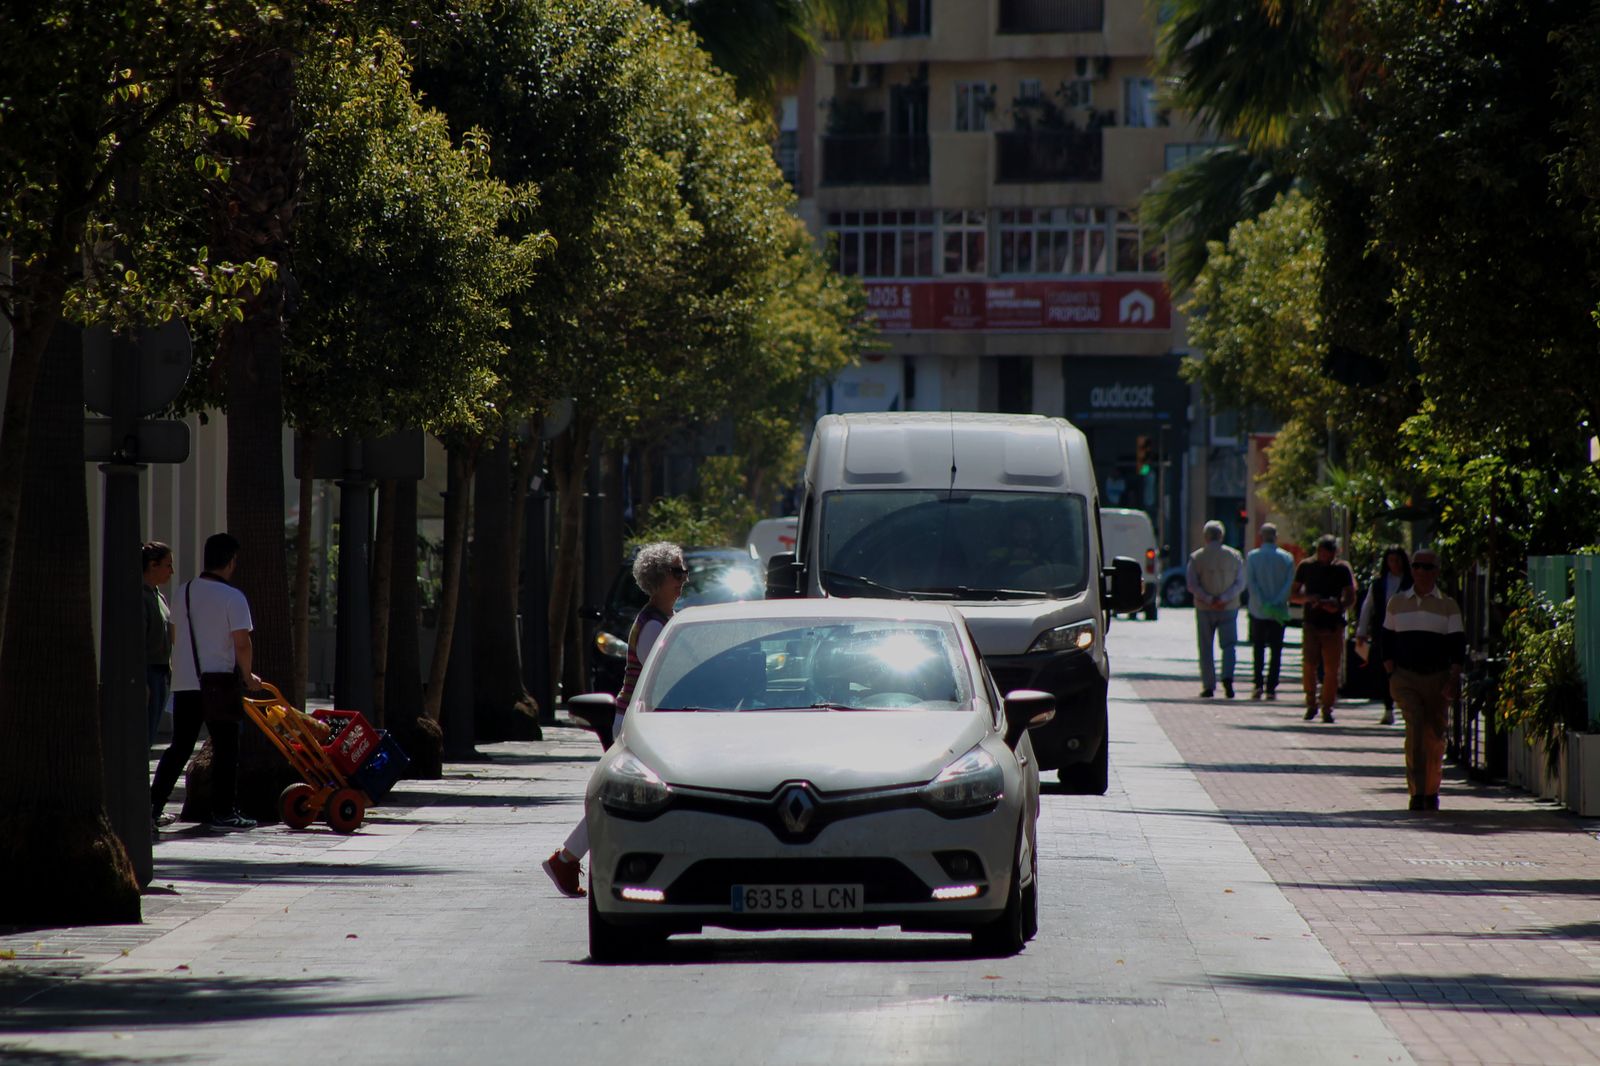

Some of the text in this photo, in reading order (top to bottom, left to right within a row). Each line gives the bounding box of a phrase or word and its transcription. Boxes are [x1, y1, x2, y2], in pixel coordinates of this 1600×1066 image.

[1090, 382, 1155, 408] audicost
[745, 887, 856, 910] 6358 LCN
